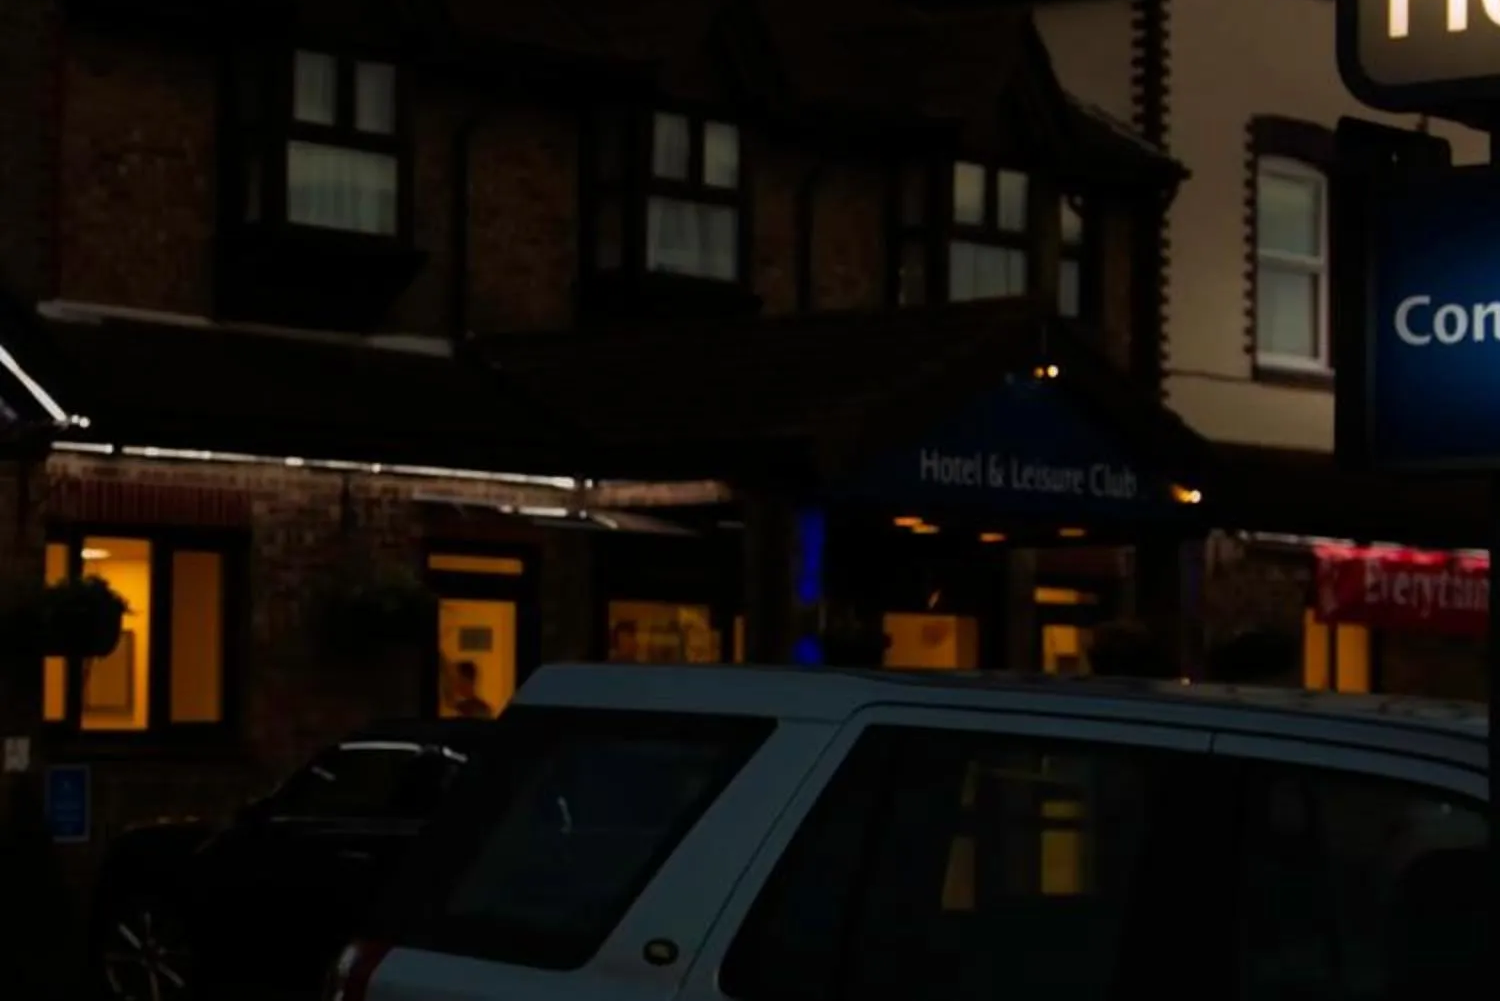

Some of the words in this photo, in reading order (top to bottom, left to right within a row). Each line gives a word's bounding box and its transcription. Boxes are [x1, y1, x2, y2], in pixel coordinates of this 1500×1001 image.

[918, 445, 984, 491] Hotel
[986, 453, 1006, 490] &
[1009, 452, 1084, 496] Leisure
[1088, 462, 1139, 499] Club
